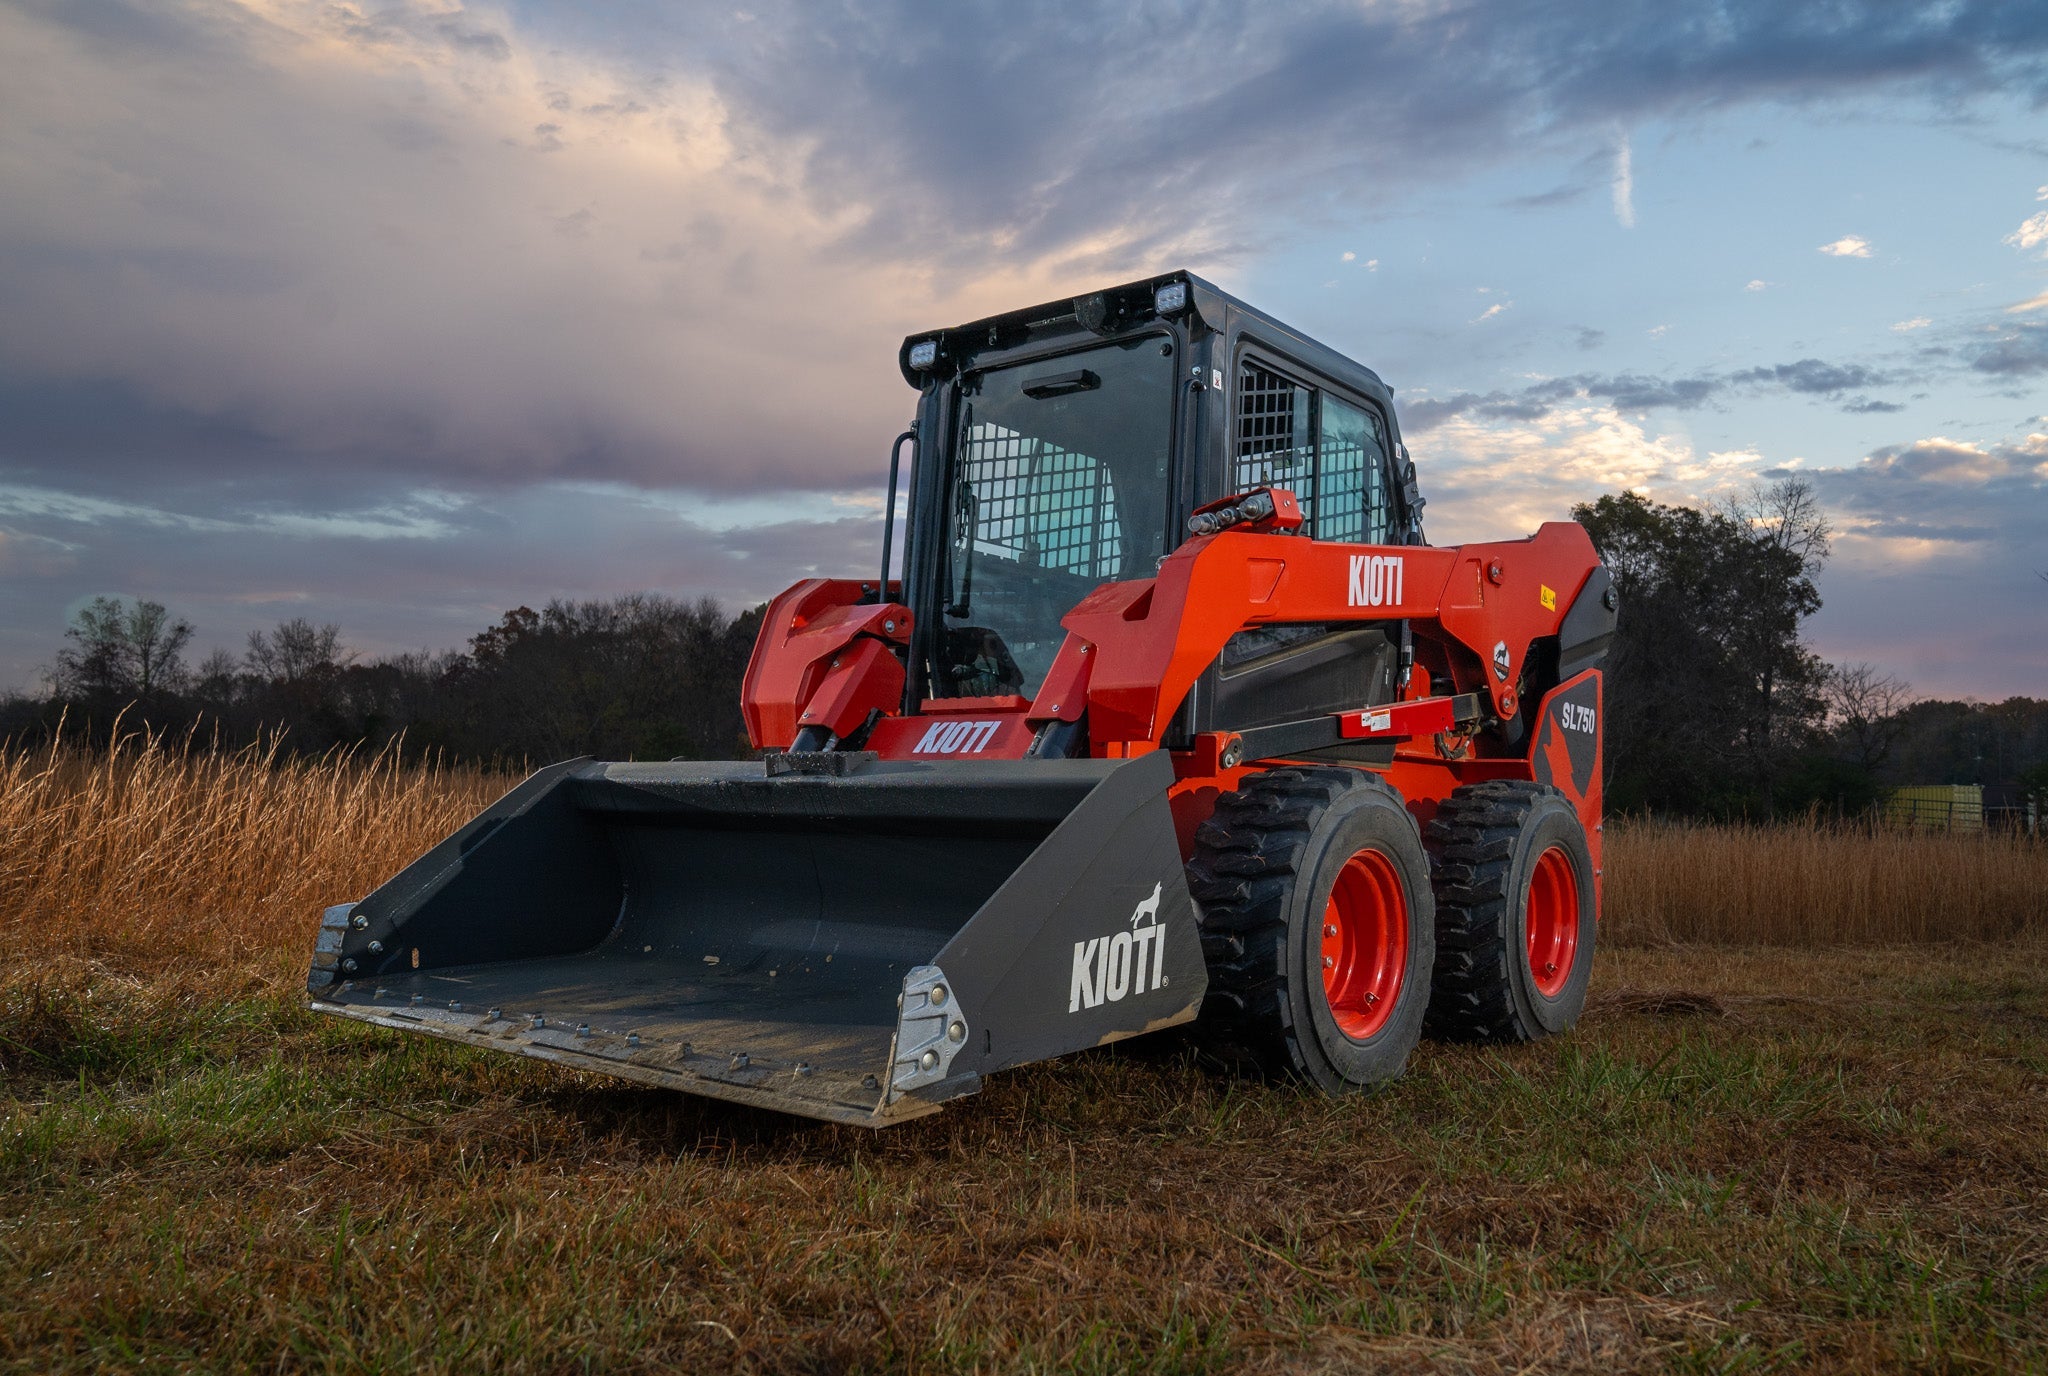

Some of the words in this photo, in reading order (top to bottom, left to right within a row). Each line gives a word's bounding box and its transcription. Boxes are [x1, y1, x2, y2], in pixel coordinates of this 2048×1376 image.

[1348, 555, 1403, 606] KIOTI
[912, 721, 1002, 753] KIOTI
[1562, 702, 1595, 734] SL750
[1069, 923, 1166, 1013] KIOTI
